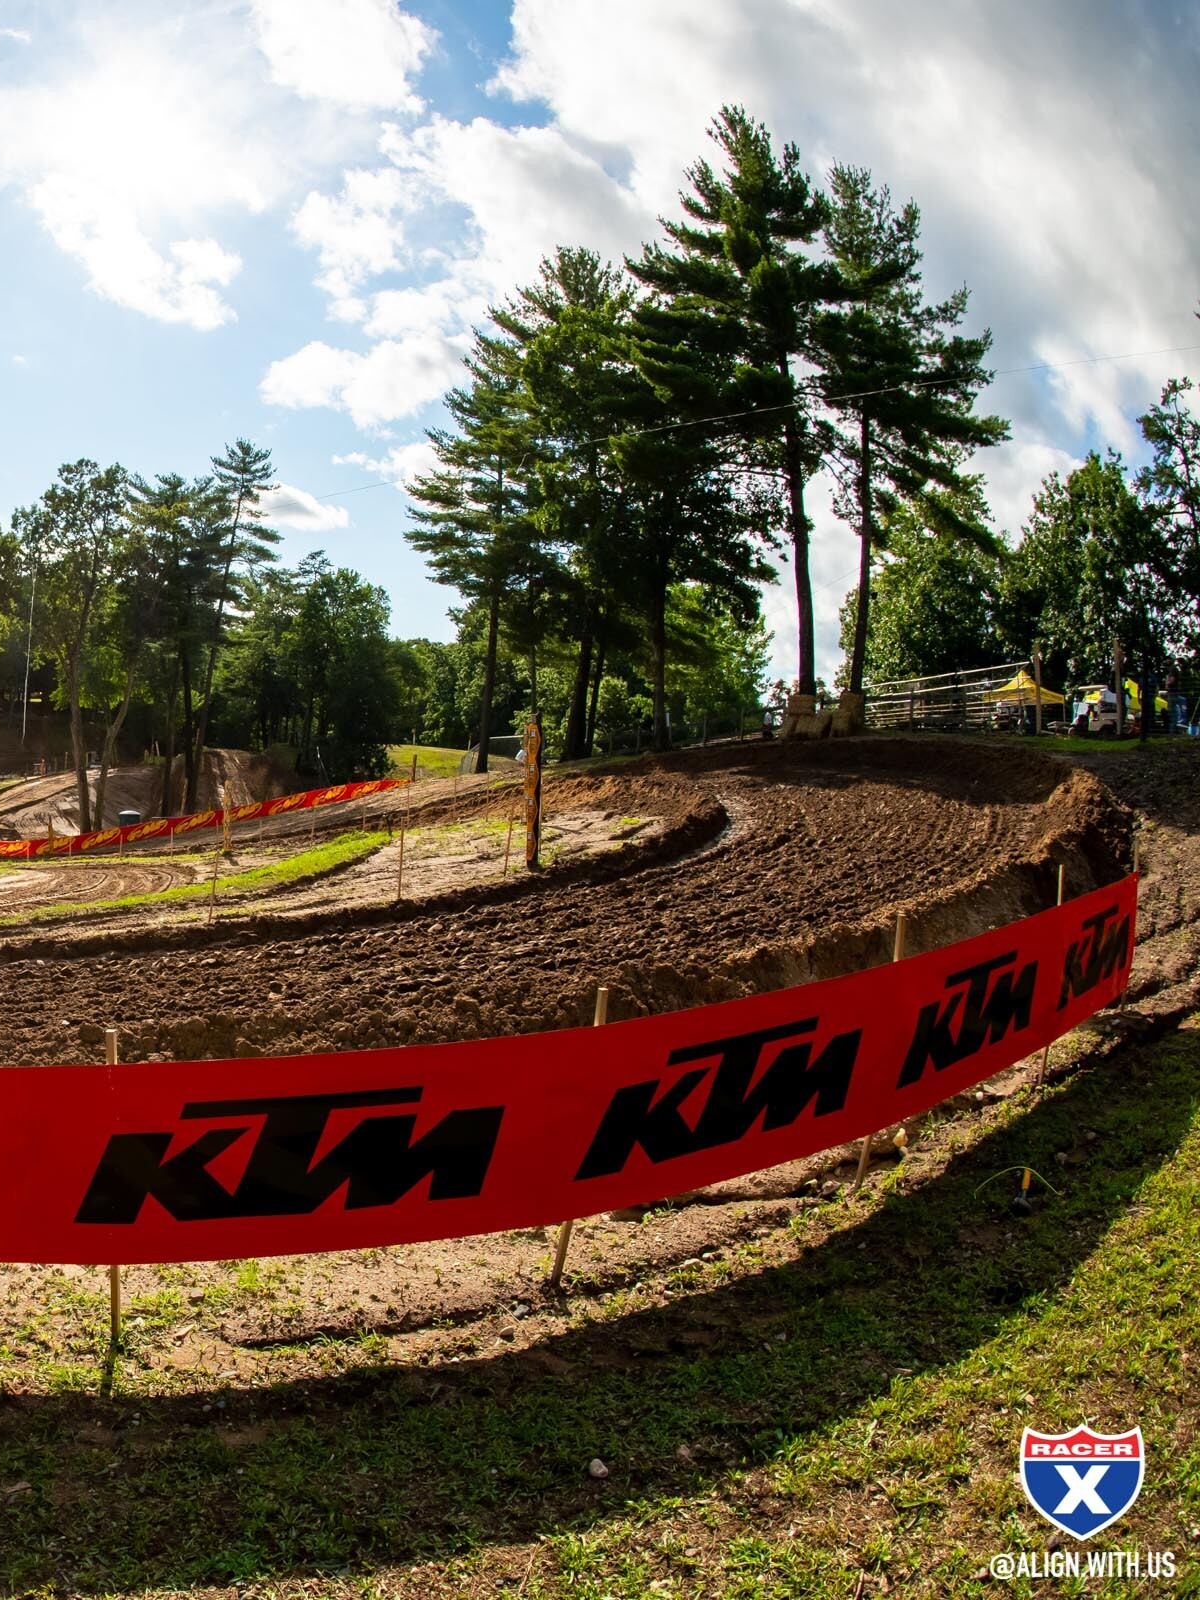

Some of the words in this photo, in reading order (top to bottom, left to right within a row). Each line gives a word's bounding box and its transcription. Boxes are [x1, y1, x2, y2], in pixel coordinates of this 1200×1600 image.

[897, 950, 1038, 1090] KTM
[1057, 904, 1130, 1012] KTM
[73, 1086, 505, 1224] KTM
[572, 1016, 863, 1181] KTM
